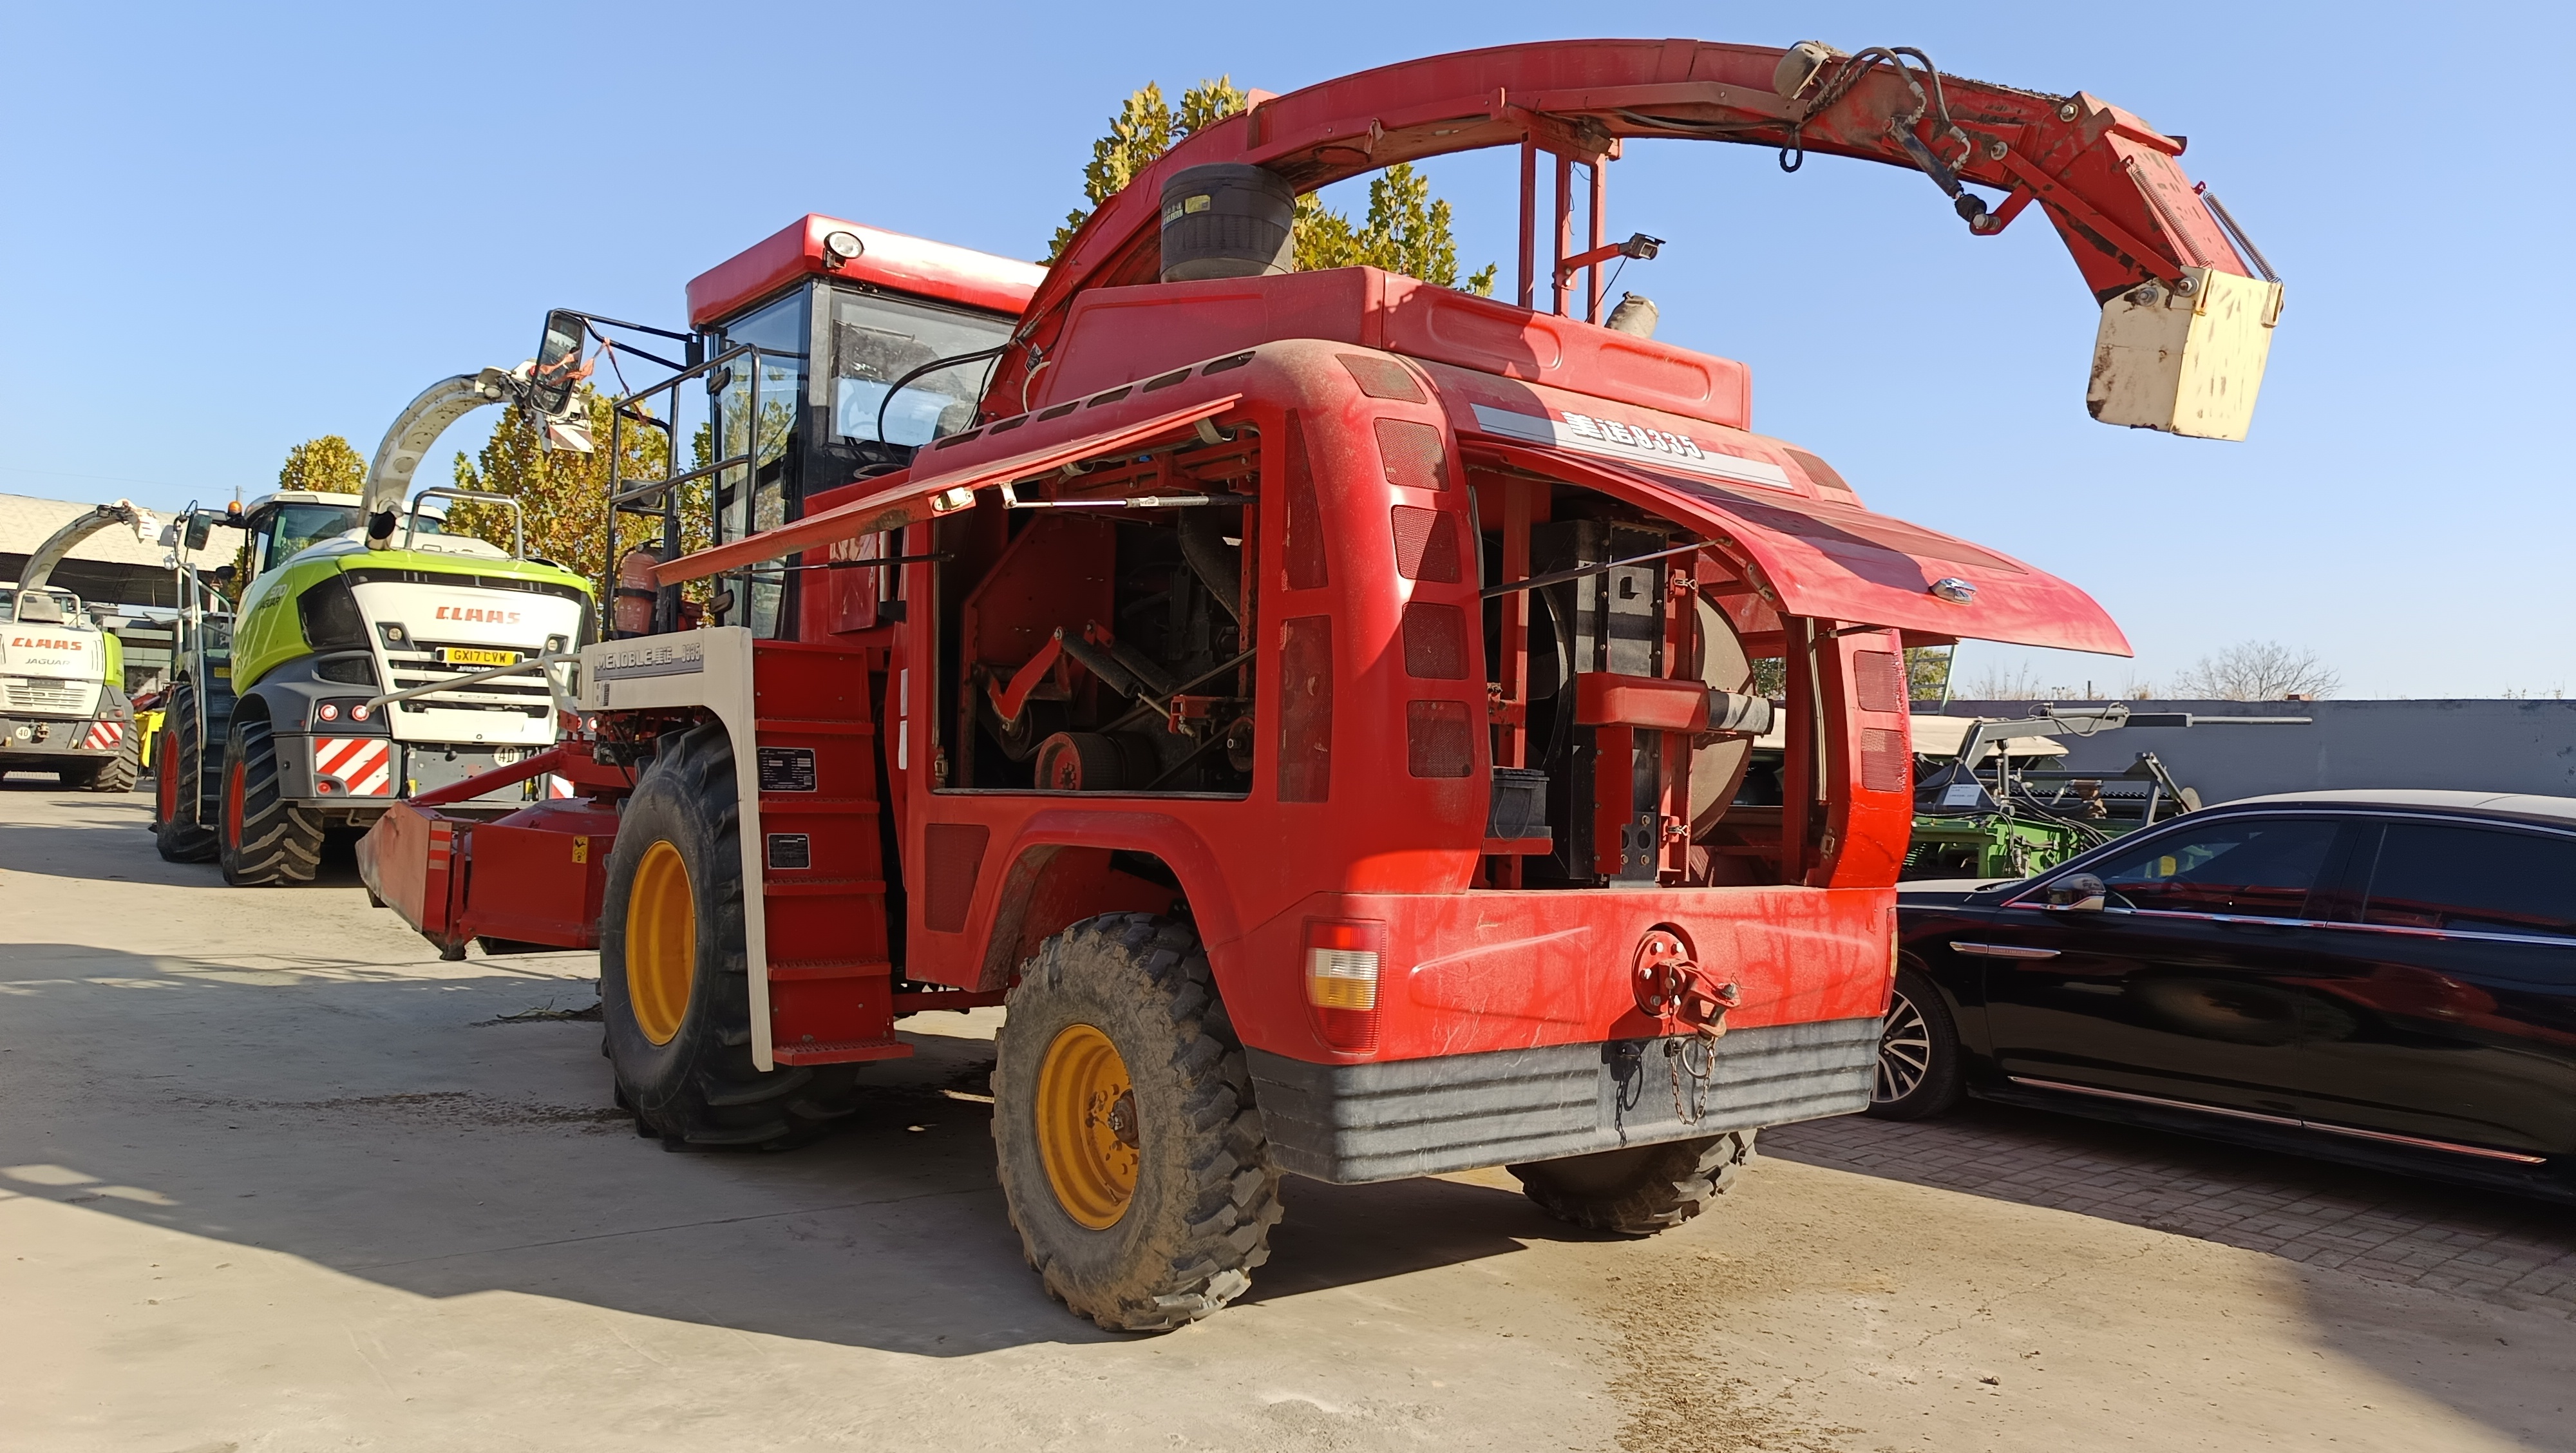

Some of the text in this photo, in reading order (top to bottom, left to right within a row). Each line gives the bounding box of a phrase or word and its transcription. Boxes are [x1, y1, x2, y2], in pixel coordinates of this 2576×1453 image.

[1560, 411, 1705, 460] 美诺9335
[269, 584, 287, 598] 970
[435, 606, 521, 624] CLAAS
[12, 638, 82, 650] CLAAS
[453, 650, 507, 663] GX17 CVW
[597, 649, 653, 671] MENOBLE
[681, 642, 701, 663] 9335
[19, 728, 28, 737] 40
